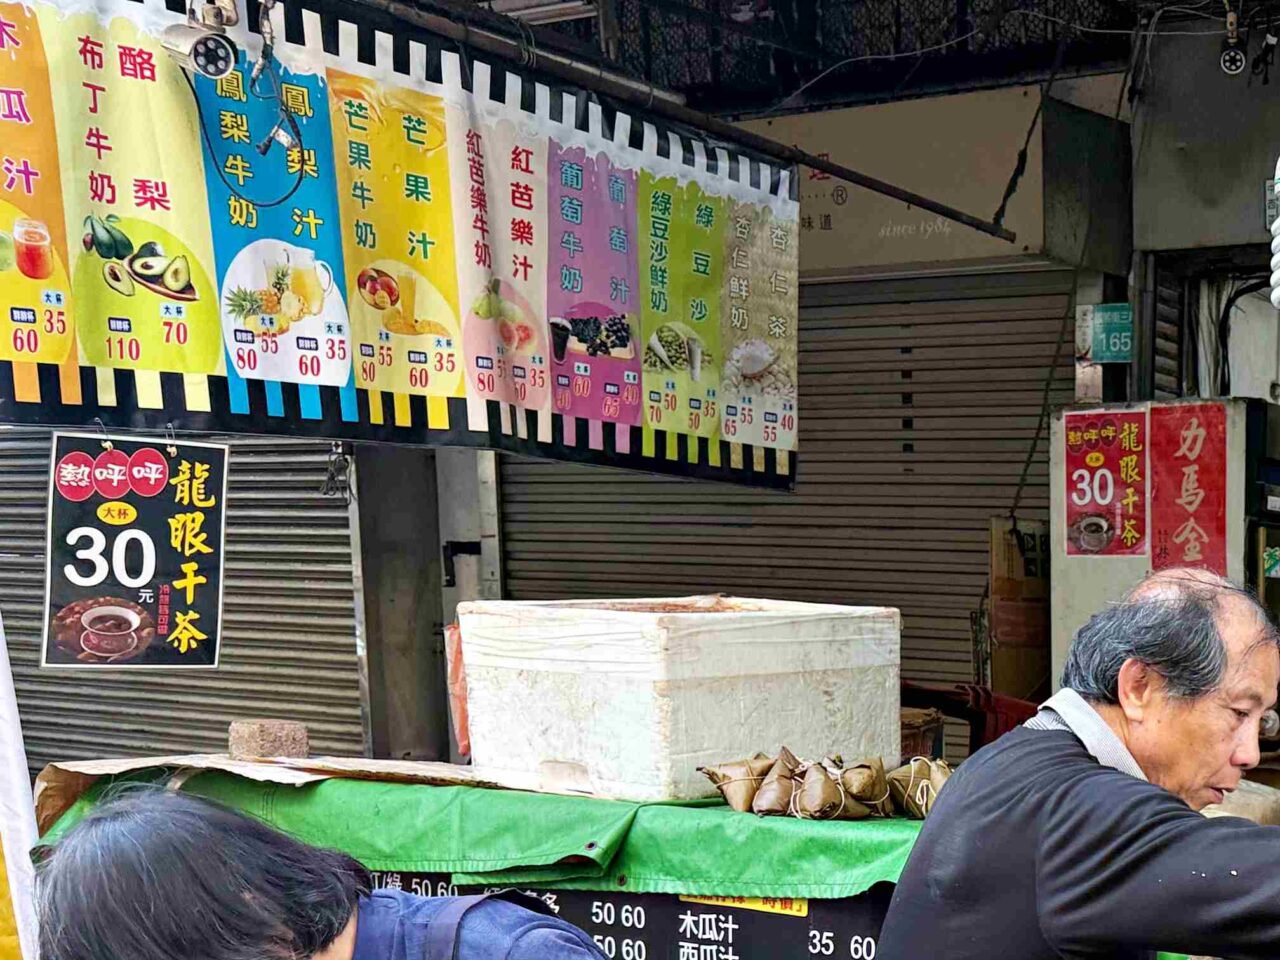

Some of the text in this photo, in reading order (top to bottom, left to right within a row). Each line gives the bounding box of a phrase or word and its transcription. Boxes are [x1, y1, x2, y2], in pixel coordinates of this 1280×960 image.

[78, 35, 117, 206] 布丁牛奶
[118, 44, 171, 212] 酪梨
[215, 68, 259, 229] 鳳梨牛奶
[281, 82, 324, 240] 鳳梨汁
[344, 100, 377, 250] 芒果牛奶
[402, 114, 436, 262] 芒果汁
[465, 128, 492, 270] 紅芭樂牛奶
[510, 146, 534, 282] 紅芭樂汁
[560, 161, 584, 293] 葡萄牛奶
[609, 174, 630, 304] 葡萄汁
[650, 191, 673, 314] 綠豆沙鮮奶
[690, 203, 714, 322] 綠豆沙
[730, 216, 752, 332] 杏仁鮮奶
[769, 226, 790, 339] 杏仁茶
[44, 309, 66, 335] 35
[162, 321, 188, 345] 70
[13, 328, 39, 353] 60
[105, 336, 141, 361] 110
[261, 331, 279, 354] 55
[326, 338, 346, 361] 35
[1100, 332, 1131, 351] 165
[236, 348, 257, 371] 80
[299, 355, 321, 377] 60
[378, 345, 393, 367] 55
[434, 352, 456, 373] 35
[361, 361, 376, 383] 80
[409, 367, 429, 388] 60
[477, 372, 495, 393] 80
[530, 368, 545, 388] 35
[650, 406, 662, 423] 70
[664, 393, 677, 411] 50
[703, 401, 716, 418] 35
[724, 419, 737, 436] 65
[741, 407, 753, 424] 55
[781, 414, 794, 431] 40
[763, 426, 777, 442] 55
[1067, 426, 1117, 445] 熱呼呼
[60, 462, 164, 487] 熱呼呼
[1072, 468, 1114, 506] 30
[1119, 422, 1142, 546] 龍眼干茶
[103, 506, 130, 519] 大杯
[64, 526, 156, 588] 30
[167, 459, 216, 654] 龍眼干茶
[138, 588, 154, 604] 元
[591, 901, 646, 929] 50 60
[678, 910, 739, 944] 木瓜汁
[593, 935, 616, 959] 50
[808, 930, 876, 960] 35 60
